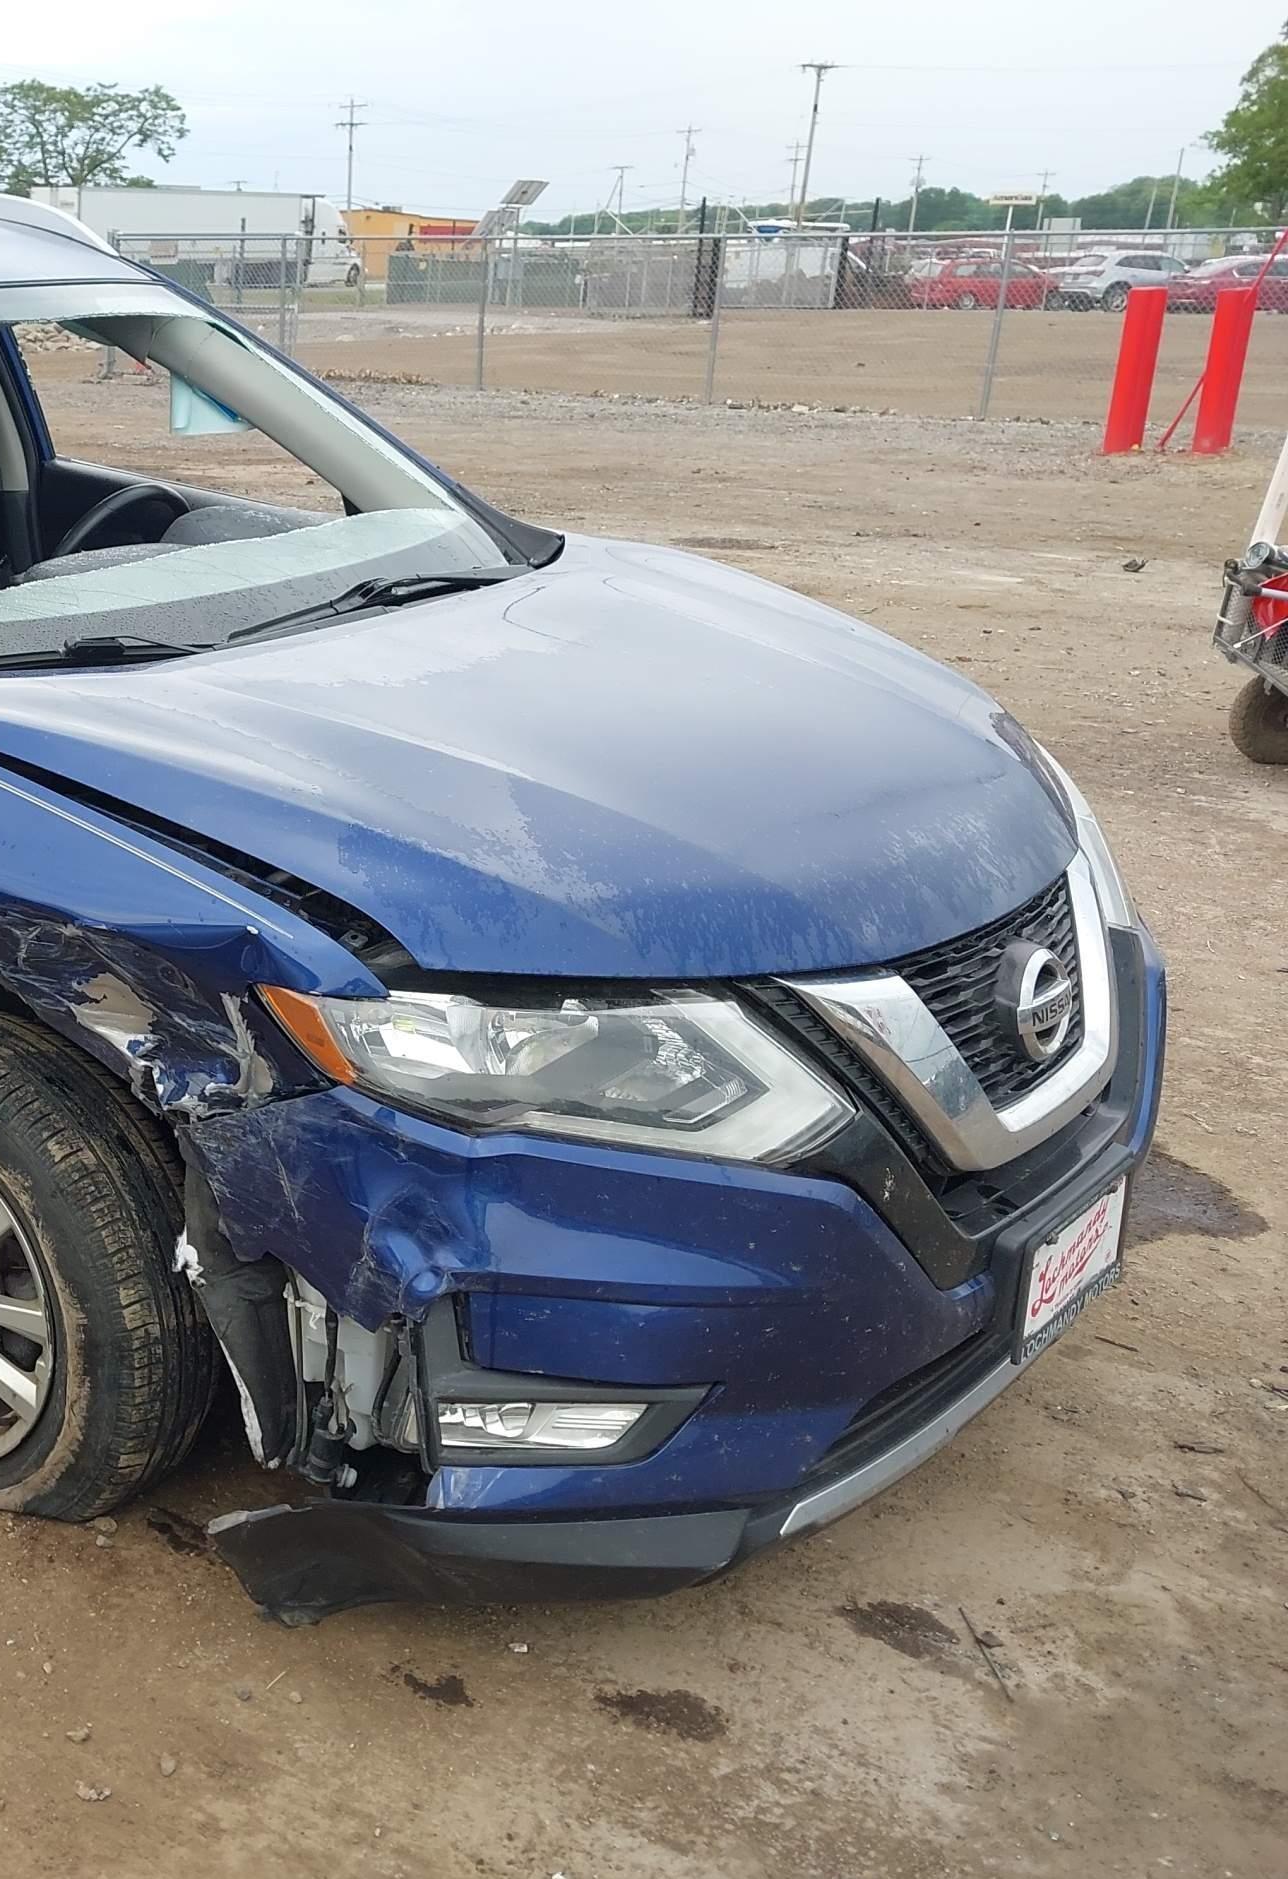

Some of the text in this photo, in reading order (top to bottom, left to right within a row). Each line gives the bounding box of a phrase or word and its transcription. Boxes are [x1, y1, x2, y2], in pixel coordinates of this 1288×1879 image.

[1020, 1296, 1084, 1363] LOCHMANDY
[1083, 1262, 1121, 1309] MOTORS
[1030, 1199, 1110, 1318] Lochmandy
